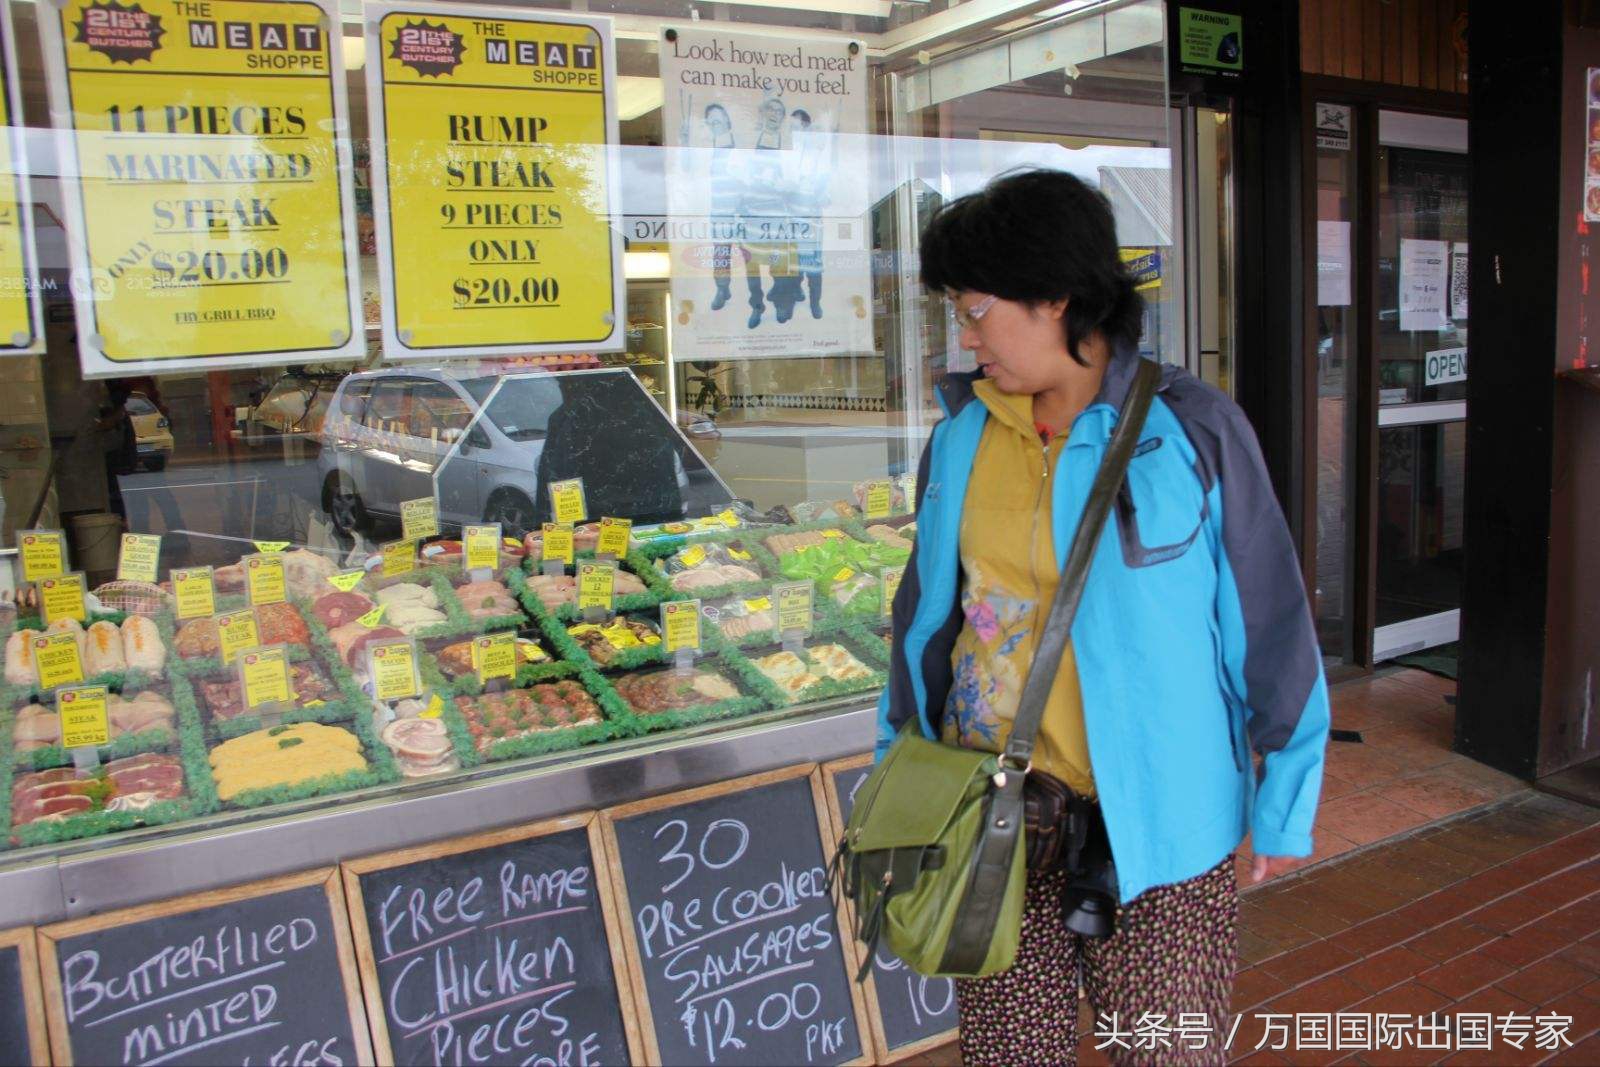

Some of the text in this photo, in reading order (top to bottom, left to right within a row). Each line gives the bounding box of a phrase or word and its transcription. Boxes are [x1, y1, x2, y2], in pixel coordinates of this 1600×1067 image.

[173, 1, 212, 17] THE
[1191, 12, 1230, 26] WARNING
[87, 27, 152, 38] CENTURY
[190, 24, 319, 49] MEAT
[473, 22, 505, 36] THE
[87, 37, 153, 48] BUTCHER
[402, 45, 454, 54] CENTURY
[488, 42, 593, 67] MEAT
[674, 39, 855, 72] Look how red meat
[246, 54, 324, 69] SHOPPE
[402, 54, 456, 63] BUTCHER
[533, 70, 598, 85] SHOPPE
[681, 68, 850, 96] can make you feel.
[106, 104, 307, 136] 11 PIECES
[448, 114, 548, 142] RUMP
[106, 152, 313, 182] MARINATED
[446, 160, 554, 188] STEAK
[153, 198, 280, 230] STEAK
[441, 203, 562, 226] 9 PIECES
[108, 239, 153, 280] ONLY
[469, 239, 540, 261] ONLY
[151, 246, 289, 283] $20.00
[453, 277, 560, 306] $20.00
[1428, 353, 1467, 380] OPEN
[654, 819, 749, 893] 30
[680, 982, 820, 1062] $12.00
